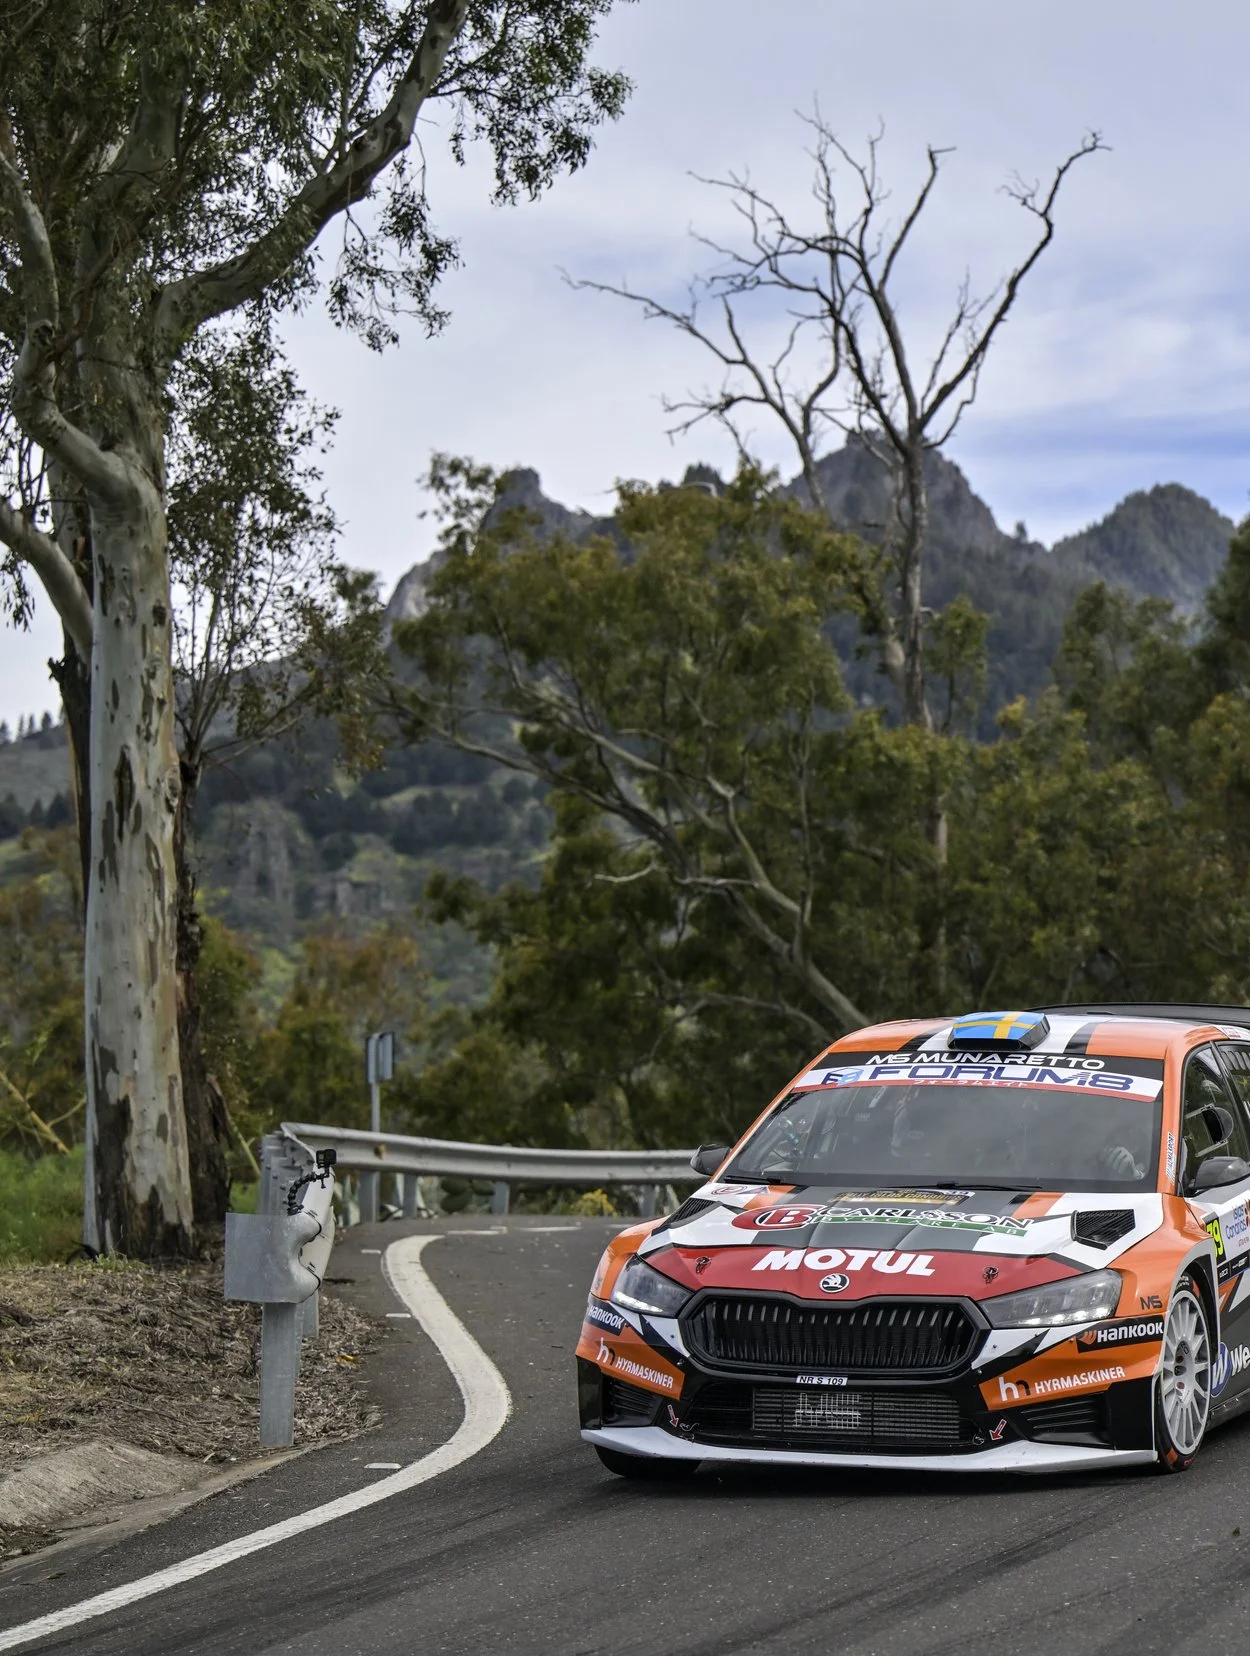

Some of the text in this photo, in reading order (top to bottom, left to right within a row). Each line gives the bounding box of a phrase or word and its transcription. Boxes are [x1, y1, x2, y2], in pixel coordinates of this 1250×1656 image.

[865, 1052, 1106, 1070] MS MUNARETTO
[868, 1065, 1134, 1091] FORUM8
[751, 1248, 936, 1277] MOTUL
[1139, 1295, 1163, 1310] MS
[616, 1357, 674, 1389] HYRMASKINER
[799, 1376, 814, 1384] NR
[828, 1377, 844, 1385] 109
[1034, 1366, 1126, 1395] HYRMASKINER
